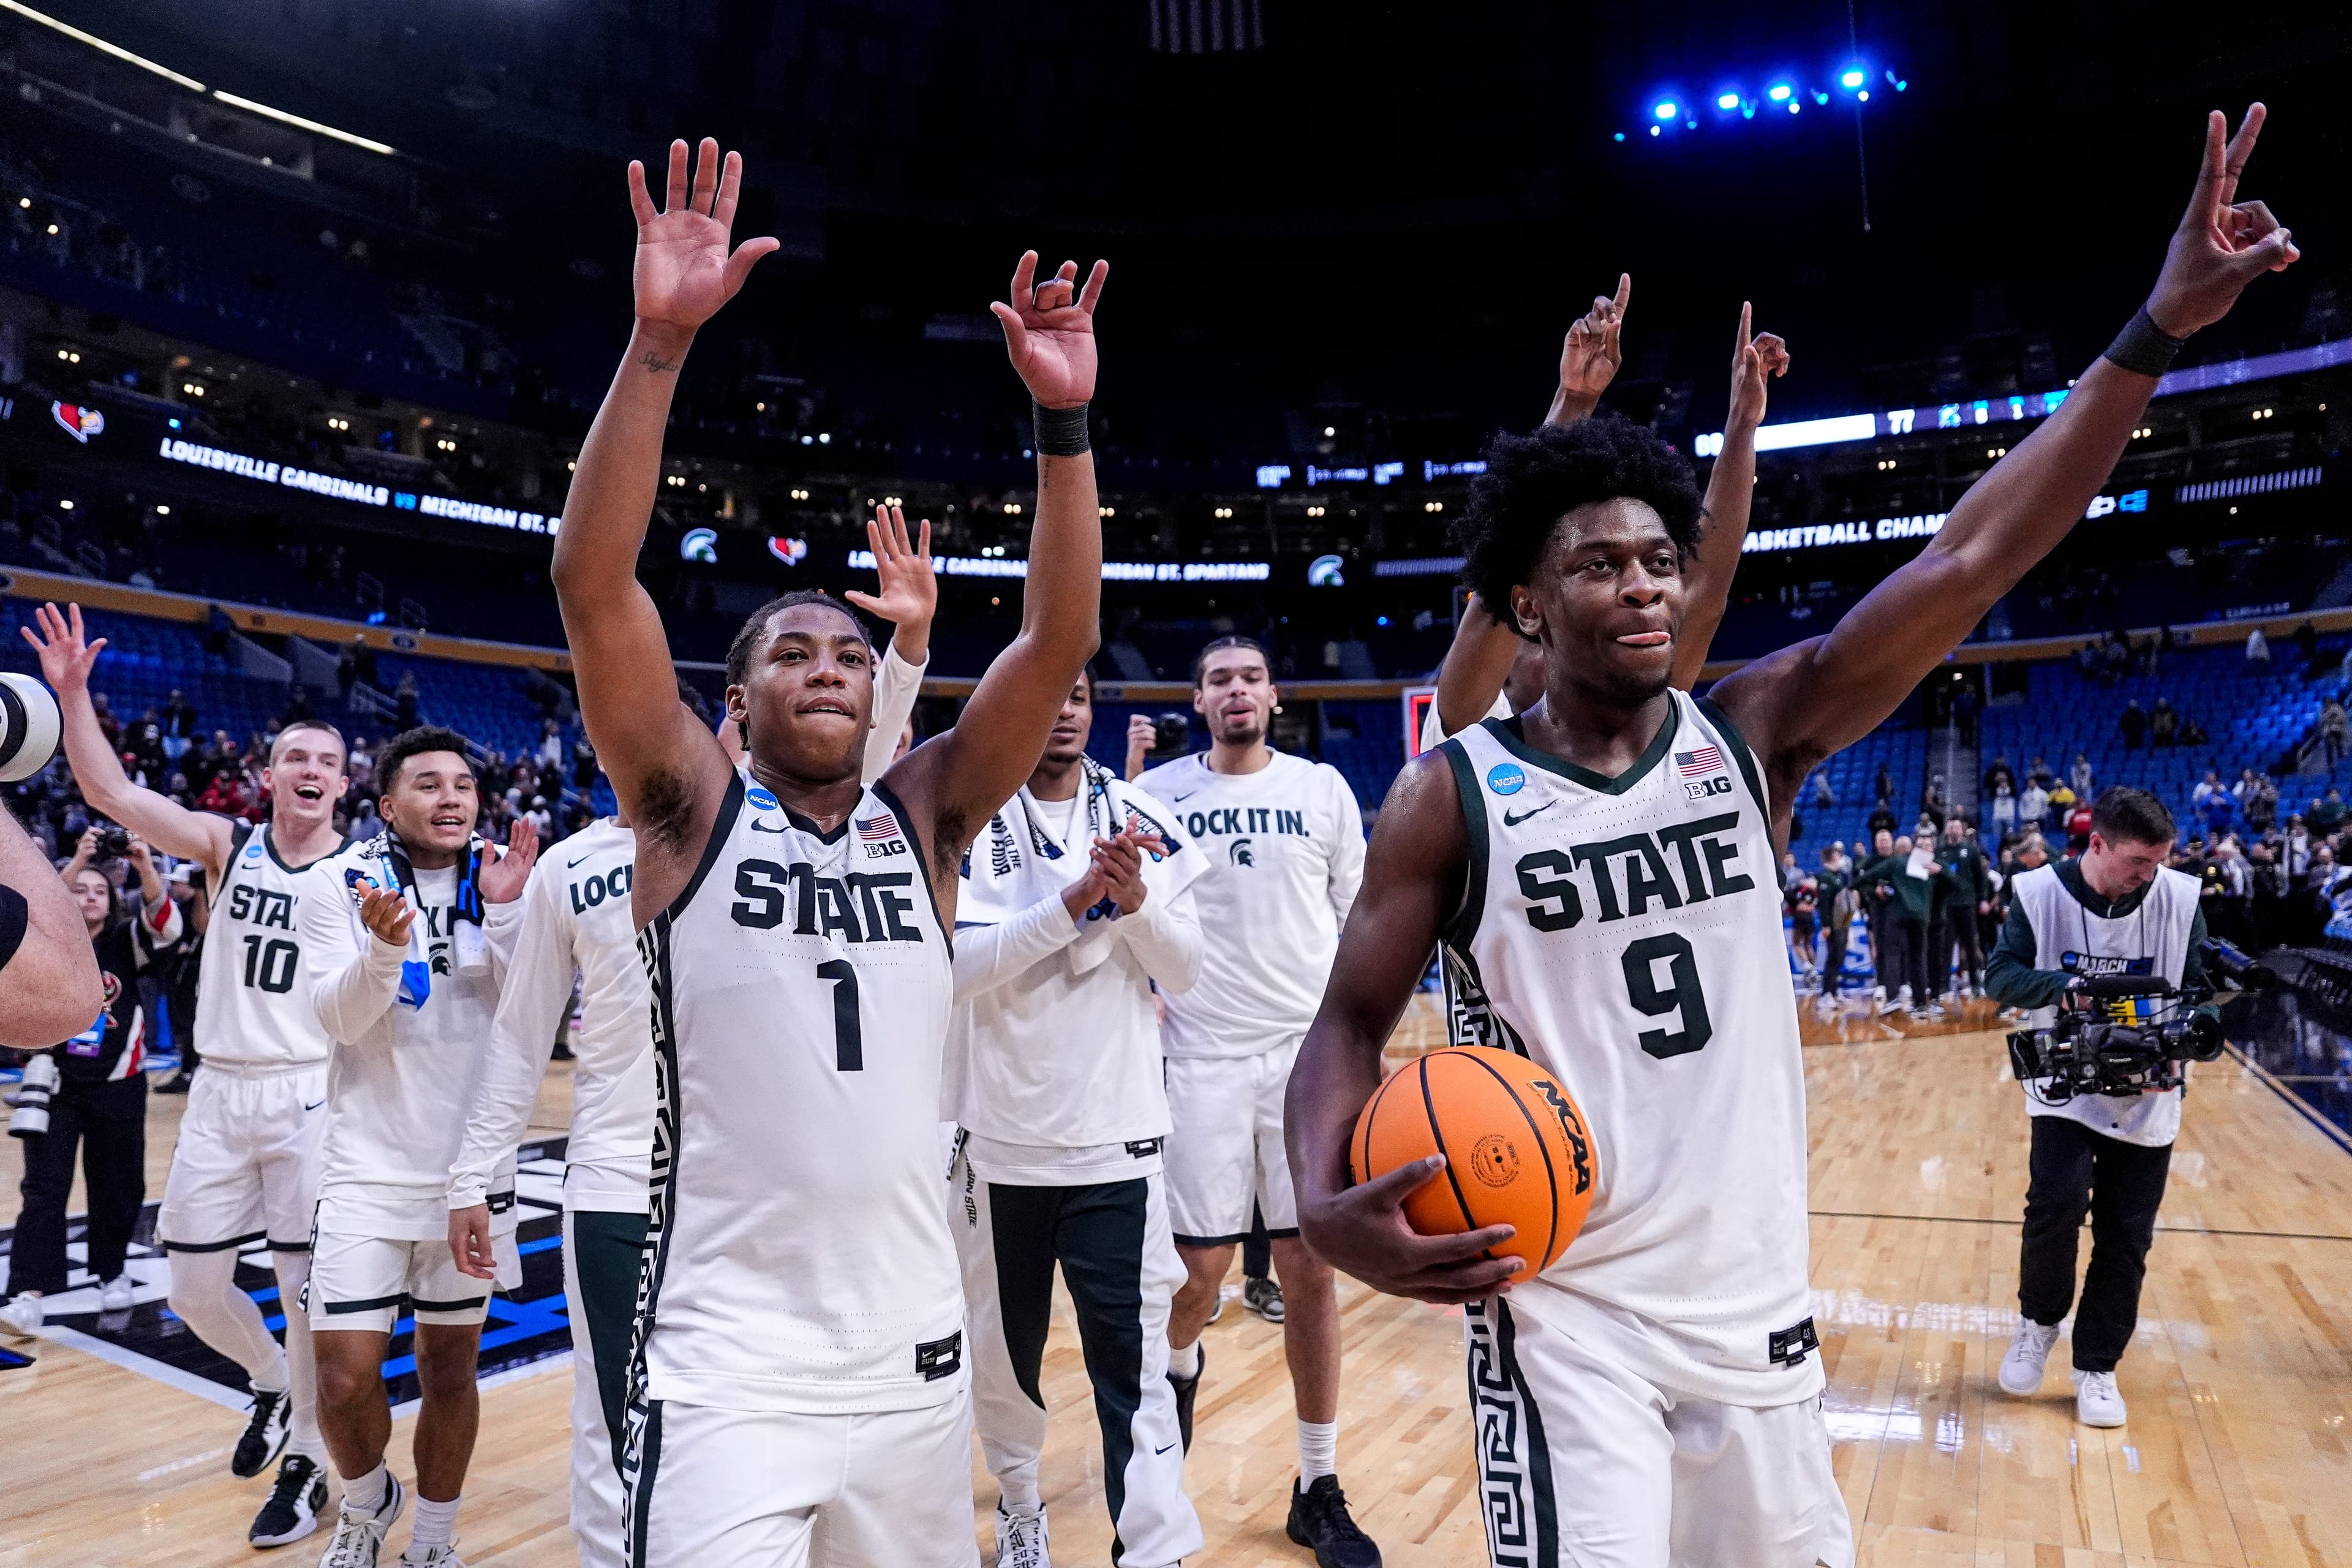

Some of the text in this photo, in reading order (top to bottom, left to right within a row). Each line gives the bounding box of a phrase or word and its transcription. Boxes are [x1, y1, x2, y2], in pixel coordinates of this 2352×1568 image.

[1888, 409, 1915, 435] 77
[159, 437, 280, 483] LOUISVILLE
[281, 466, 389, 507] CARDINALS
[394, 491, 417, 511] VS
[420, 495, 518, 529] MICHIGAN
[518, 512, 545, 533] ST.
[1743, 513, 1950, 552] ASKETBALL CHAM
[1183, 563, 1270, 581] SPARTANS
[750, 794, 777, 808] NCAA
[1494, 775, 1523, 788] NCAA
[1176, 808, 1243, 838] OCK
[1248, 808, 1270, 834] IT
[1276, 809, 1310, 838] IN.
[731, 858, 924, 943] STATE
[1515, 810, 1755, 933] STATE
[243, 934, 300, 993] 10
[817, 959, 864, 1072] 1
[1621, 932, 1713, 1060] 9
[1531, 1080, 1591, 1196] NCAA
